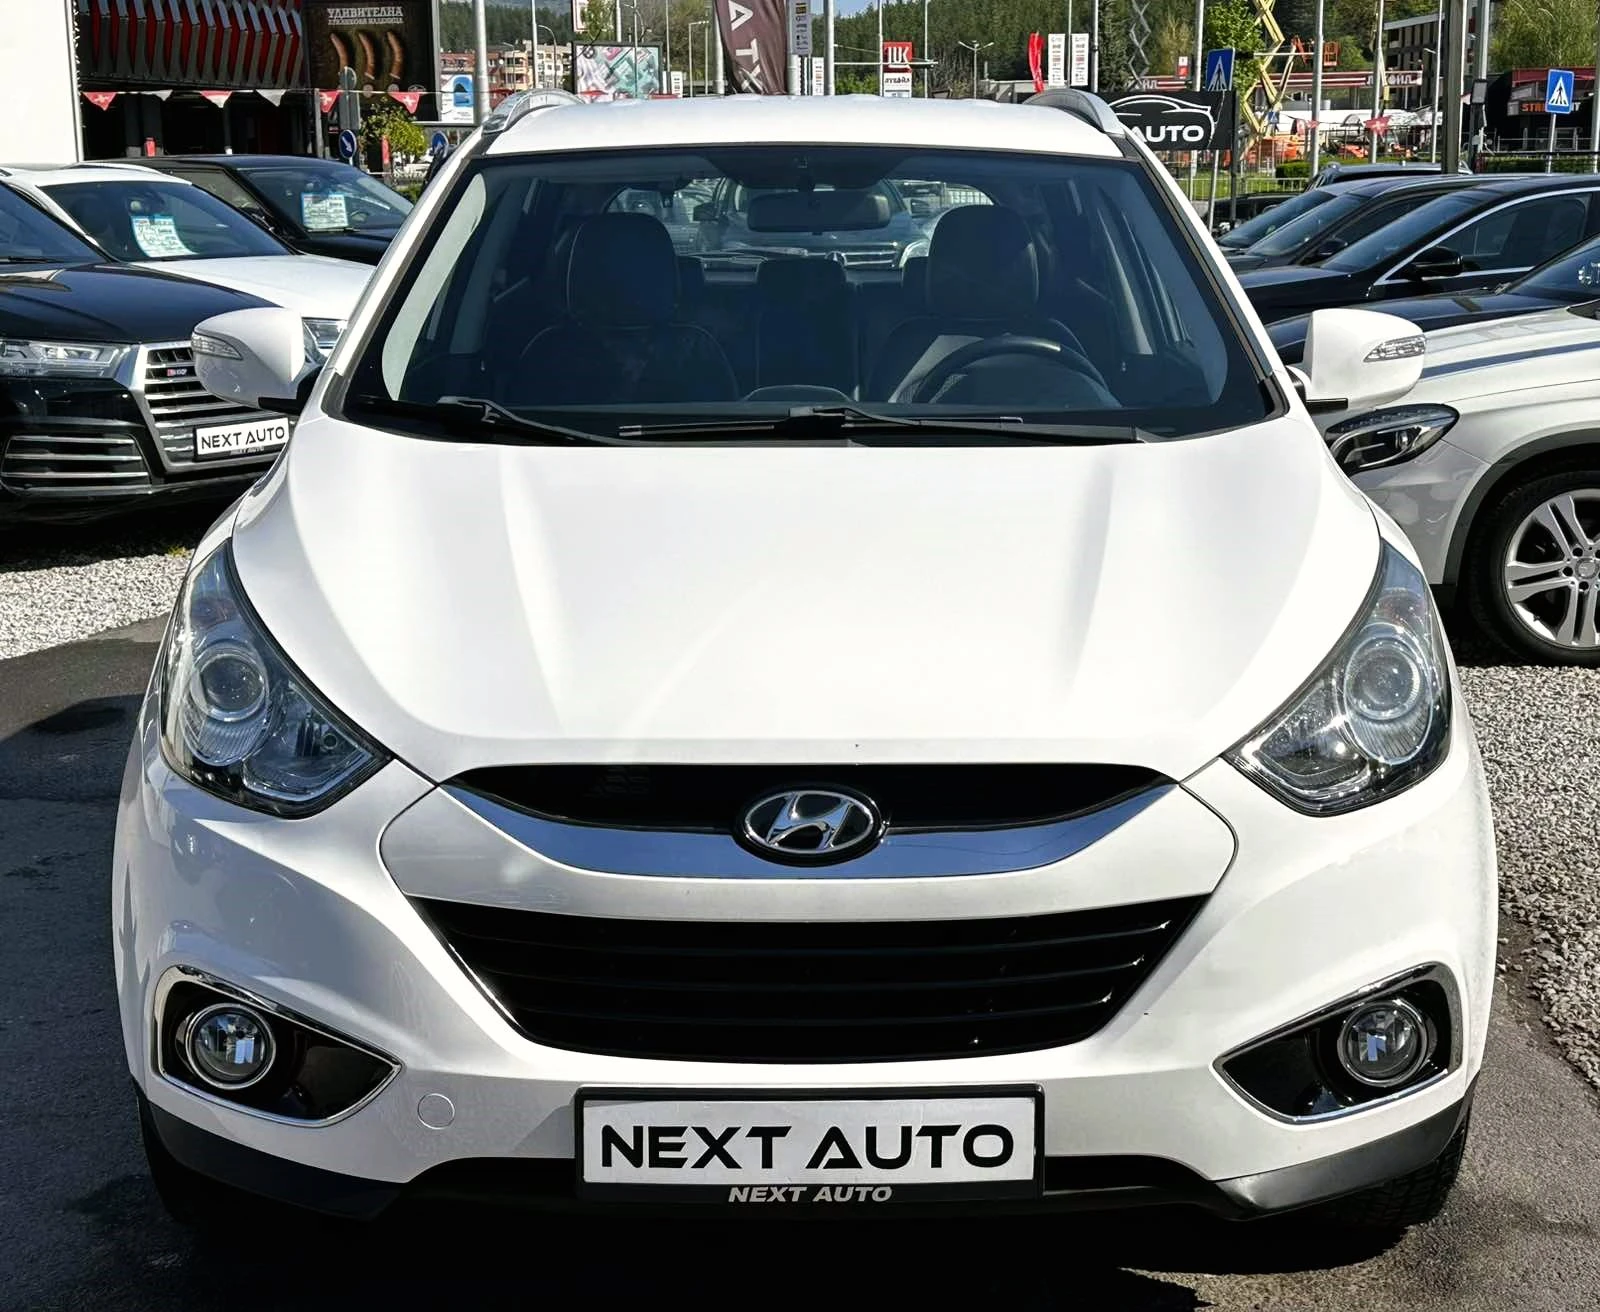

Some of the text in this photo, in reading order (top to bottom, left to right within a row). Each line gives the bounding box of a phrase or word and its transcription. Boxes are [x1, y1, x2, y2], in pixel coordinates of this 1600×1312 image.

[201, 426, 285, 449] NEXT AUTO
[601, 1124, 1015, 1169] NEXT AUTO
[728, 1186, 893, 1203] NEXT AUTO
